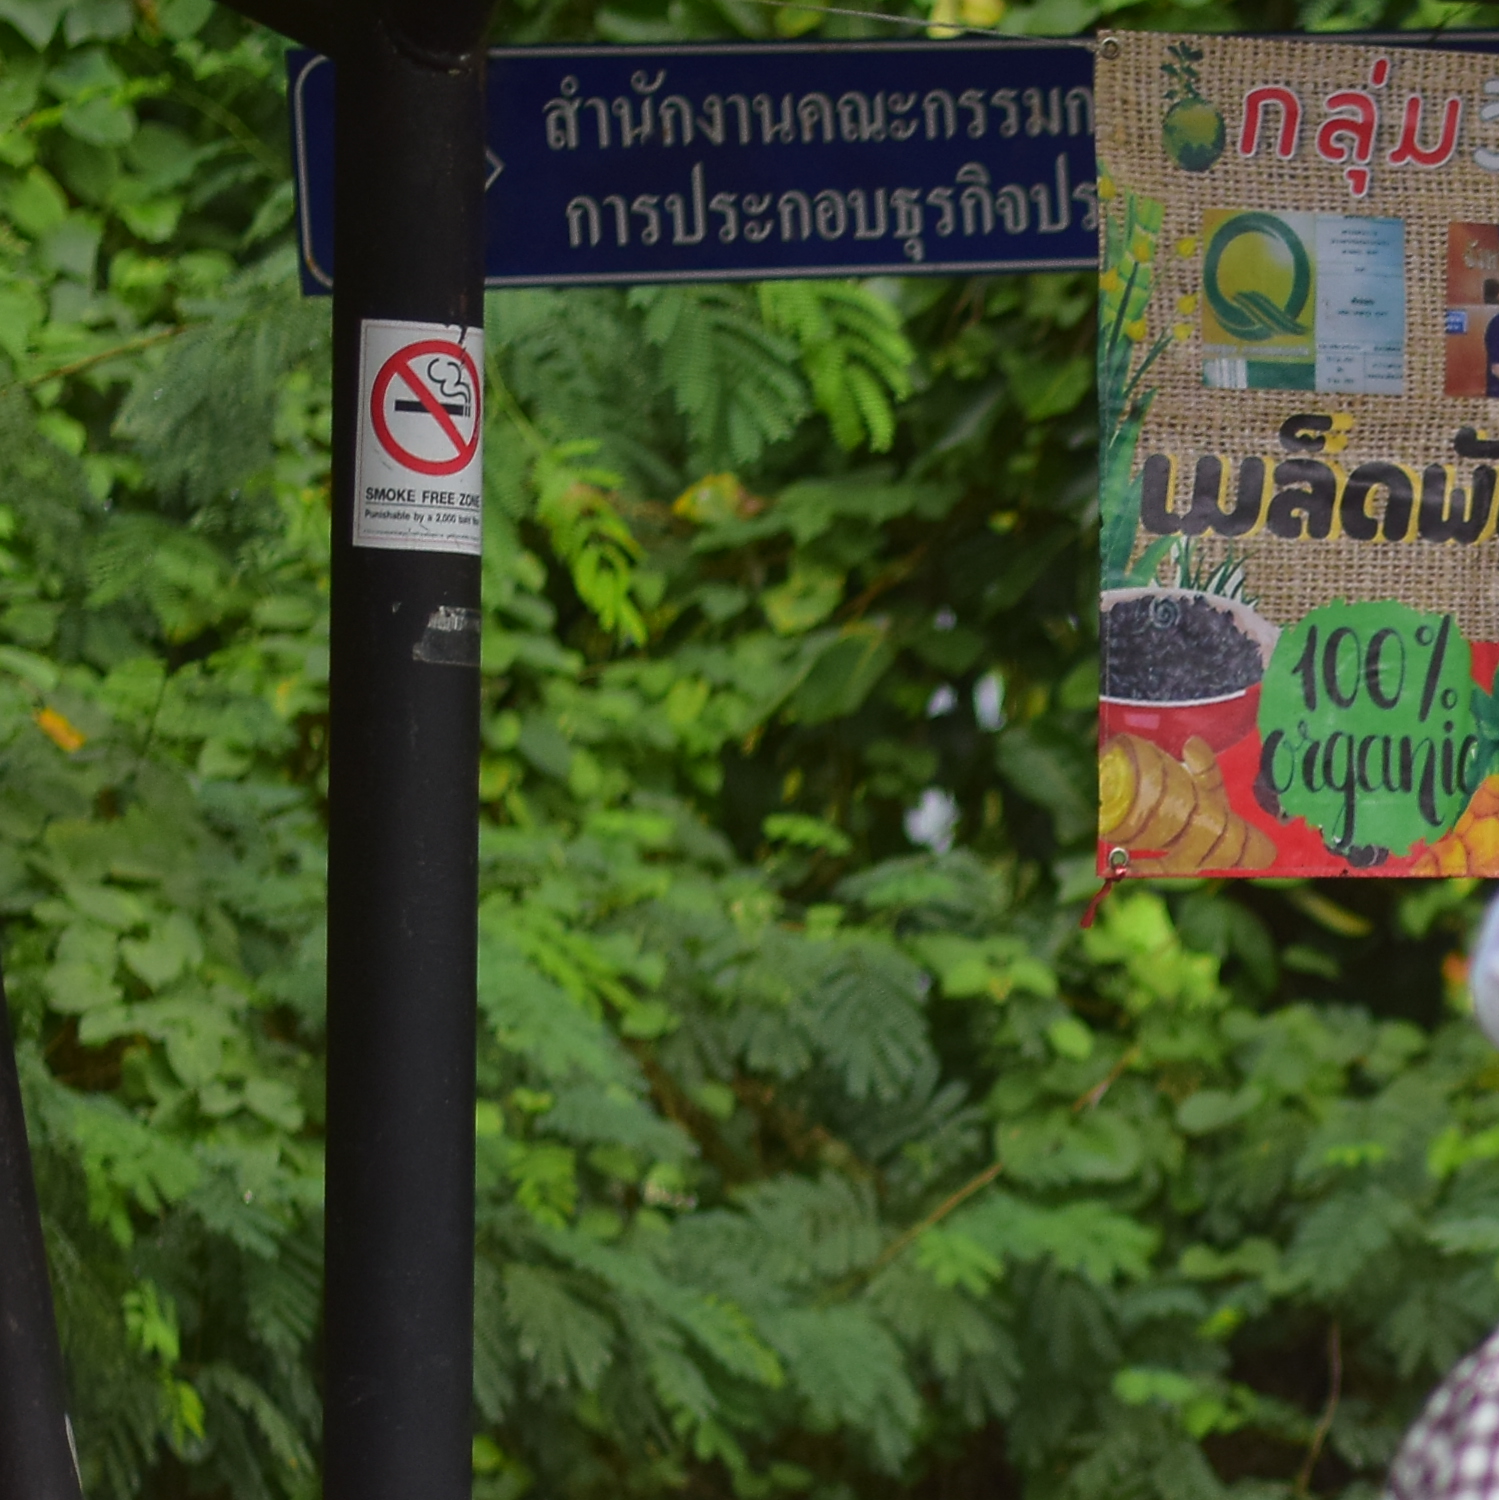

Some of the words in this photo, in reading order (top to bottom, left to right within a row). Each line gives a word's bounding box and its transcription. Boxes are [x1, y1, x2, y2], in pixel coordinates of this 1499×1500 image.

[366, 487, 416, 502] SMOKE
[422, 490, 455, 505] FREE
[459, 493, 480, 508] ZONE
[1292, 614, 1458, 722] 100%
[1260, 720, 1478, 849] organic
